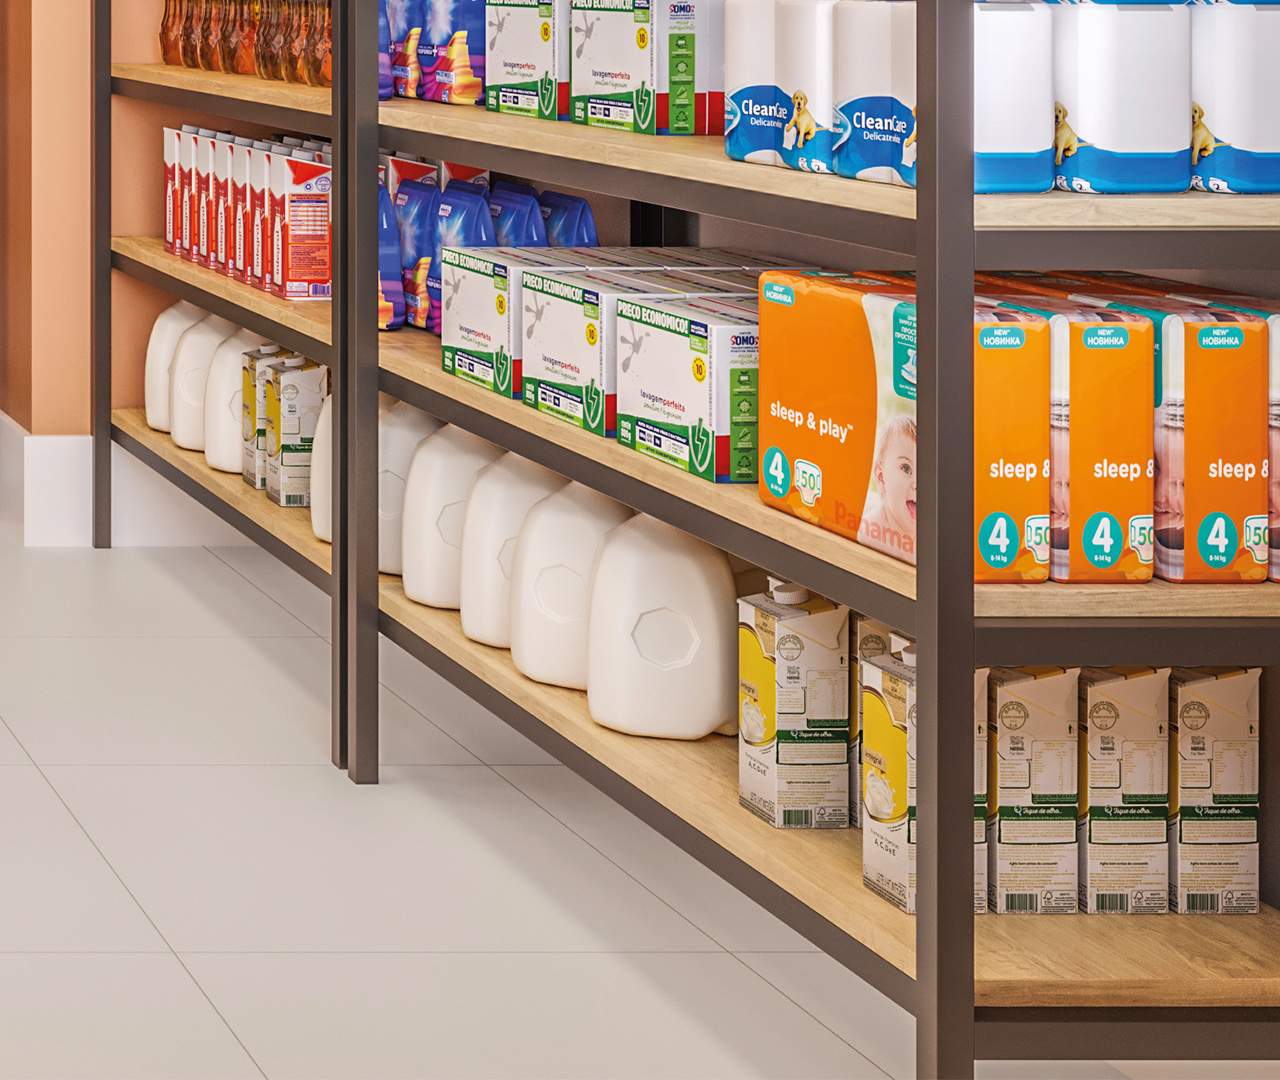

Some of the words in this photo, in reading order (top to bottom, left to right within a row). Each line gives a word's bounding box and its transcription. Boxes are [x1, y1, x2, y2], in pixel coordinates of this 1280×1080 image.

[669, 4, 695, 13] SOMOS
[544, 28, 548, 37] 10
[640, 34, 645, 43] 10
[742, 99, 787, 120] CleanCare
[853, 112, 906, 134] CleanCare
[442, 250, 459, 264] PREÇO
[460, 254, 494, 275] ECONÔMICO!
[524, 273, 542, 288] PREÇO
[544, 279, 583, 302] ECONÔMICO!
[766, 290, 792, 303] НОВИНКА
[499, 300, 503, 309] 10
[618, 301, 640, 319] PREÇO
[642, 308, 688, 334] ECONÔMICO!
[589, 329, 594, 340] 10
[984, 337, 1020, 345] НОВИНКА
[1087, 337, 1124, 345] НОВИНКА
[1203, 337, 1239, 345] НОВИНКА
[696, 364, 702, 375] 10
[770, 401, 803, 427] sleep
[807, 412, 816, 430] &
[820, 418, 847, 443] play
[769, 452, 784, 485] 4
[990, 459, 1037, 481] sleep
[1094, 459, 1141, 481] sleep
[1209, 459, 1256, 481] sleep
[801, 470, 816, 491] 50
[834, 500, 914, 555] Panama
[989, 518, 1009, 553] 4
[1092, 518, 1113, 553] 4
[1207, 518, 1228, 553] 4
